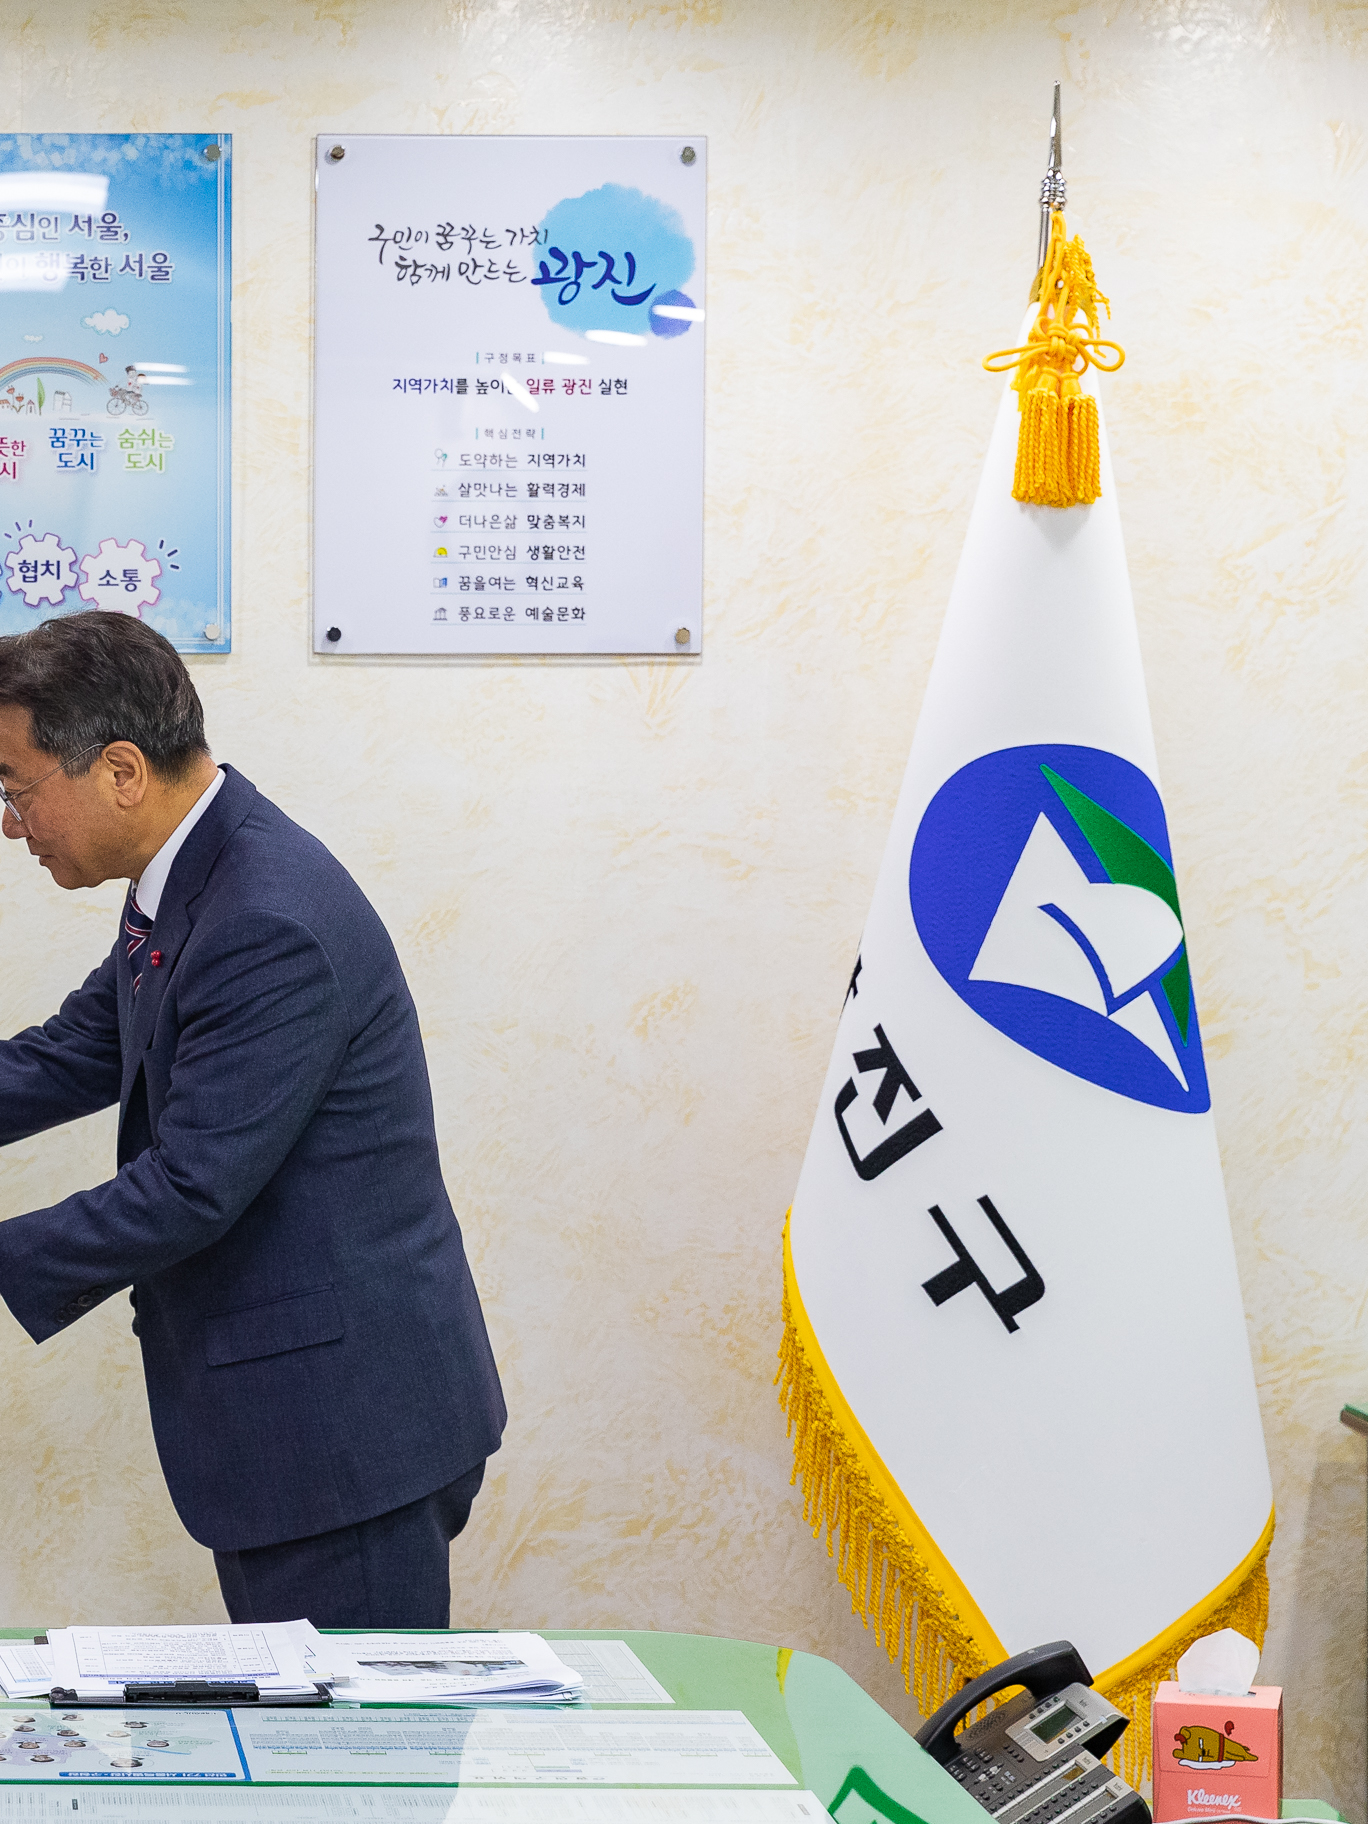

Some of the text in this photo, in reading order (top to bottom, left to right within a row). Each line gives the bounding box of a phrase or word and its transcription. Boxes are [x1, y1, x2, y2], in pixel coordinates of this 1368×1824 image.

[68, 212, 130, 242] 서울,
[368, 222, 550, 265] 구민이 꿈꾸는 가치
[34, 252, 113, 282] 행복한
[118, 252, 174, 282] 서울
[394, 246, 657, 306] 함께 만드는 광진
[392, 378, 628, 395] 지역가치를 높이 일류 광진 실현
[48, 428, 104, 449] 꿈꾸는
[117, 427, 174, 449] 숨쉬는
[56, 452, 95, 470] 도시
[125, 453, 164, 471] 도시
[459, 453, 586, 469] 도약하는 지역가치
[458, 482, 586, 498] 살맛나는 활력경제
[459, 514, 586, 530] 더나은삶 맞춤복지
[459, 545, 586, 561] 구민안심 생활안전
[17, 559, 62, 583] 협치
[97, 568, 142, 592] 소통
[459, 576, 585, 592] 꿈을여는 혁신교육
[458, 606, 586, 622] 풍요로운 예술문화
[1187, 1788, 1242, 1810] Kleenex
